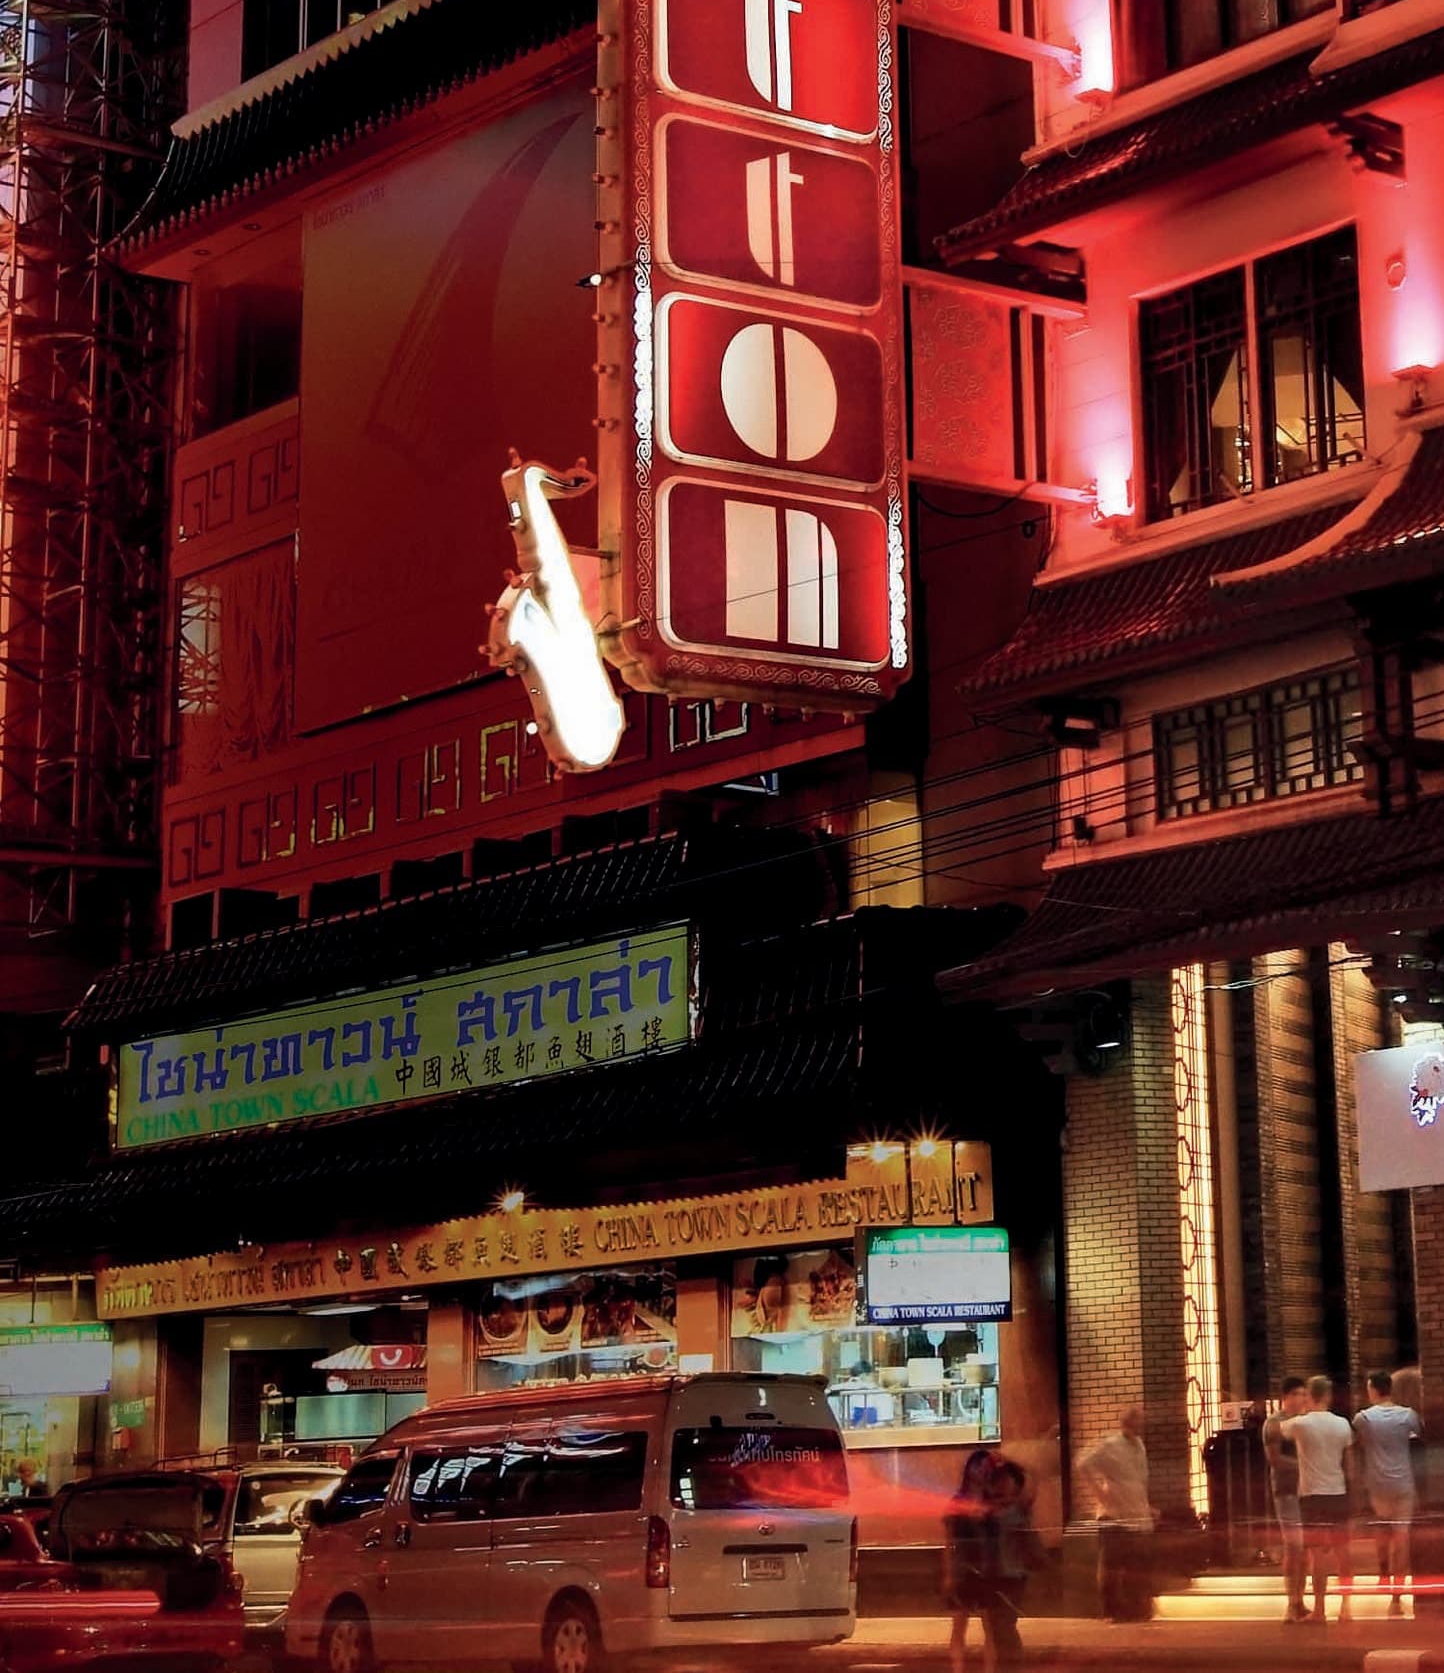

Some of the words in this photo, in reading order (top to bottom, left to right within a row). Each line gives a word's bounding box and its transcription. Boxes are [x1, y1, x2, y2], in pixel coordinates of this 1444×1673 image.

[131, 989, 422, 1103] ไชน่าทาวน์
[127, 1109, 199, 1144] CHINA
[210, 1092, 284, 1130] TOWN
[292, 1076, 380, 1114] SCALA
[594, 1207, 660, 1252] CHINA
[664, 1202, 732, 1246] TOWN
[737, 1195, 812, 1237] SCALA
[817, 1172, 979, 1227] RESTAURANT
[872, 1305, 900, 1320] CHINA
[900, 1305, 926, 1319] TOWN
[927, 1305, 953, 1318] SCALA
[953, 1303, 1006, 1317] RESTAURANT
